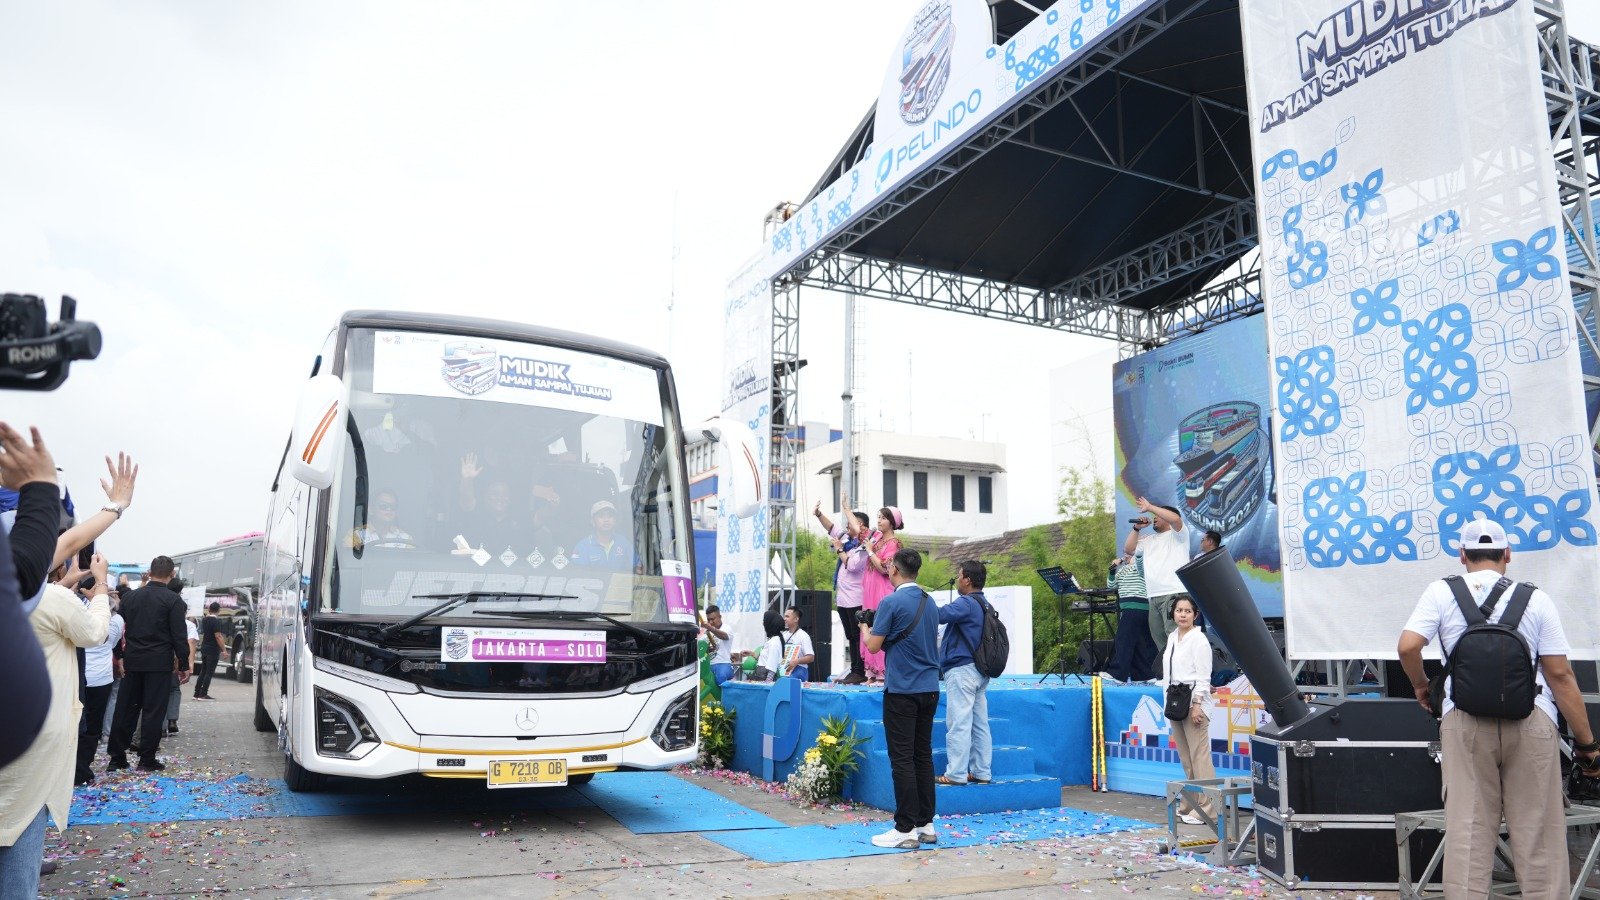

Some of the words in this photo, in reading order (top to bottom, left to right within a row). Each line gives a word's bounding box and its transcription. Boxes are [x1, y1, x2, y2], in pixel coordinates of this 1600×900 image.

[1296, 0, 1452, 82] MUD
[1260, 77, 1323, 133] AMAN
[1321, 28, 1407, 97] SAMPAI
[1408, 0, 1519, 53] TUJUA
[896, 88, 982, 171] PELINDO
[500, 355, 570, 383] MUDIK
[499, 374, 533, 390] AMAN
[533, 377, 573, 395] SAMPAI
[573, 382, 612, 401] TUJUAN
[1190, 508, 1226, 532] BUMN
[1227, 490, 1258, 531] 2025
[361, 570, 604, 613] JETBUS
[678, 579, 688, 606] 1
[477, 641, 546, 657] JAKARTA
[567, 643, 603, 658] SOLO
[493, 763, 501, 777] G
[510, 762, 540, 776] 7218
[548, 761, 563, 775] OB
